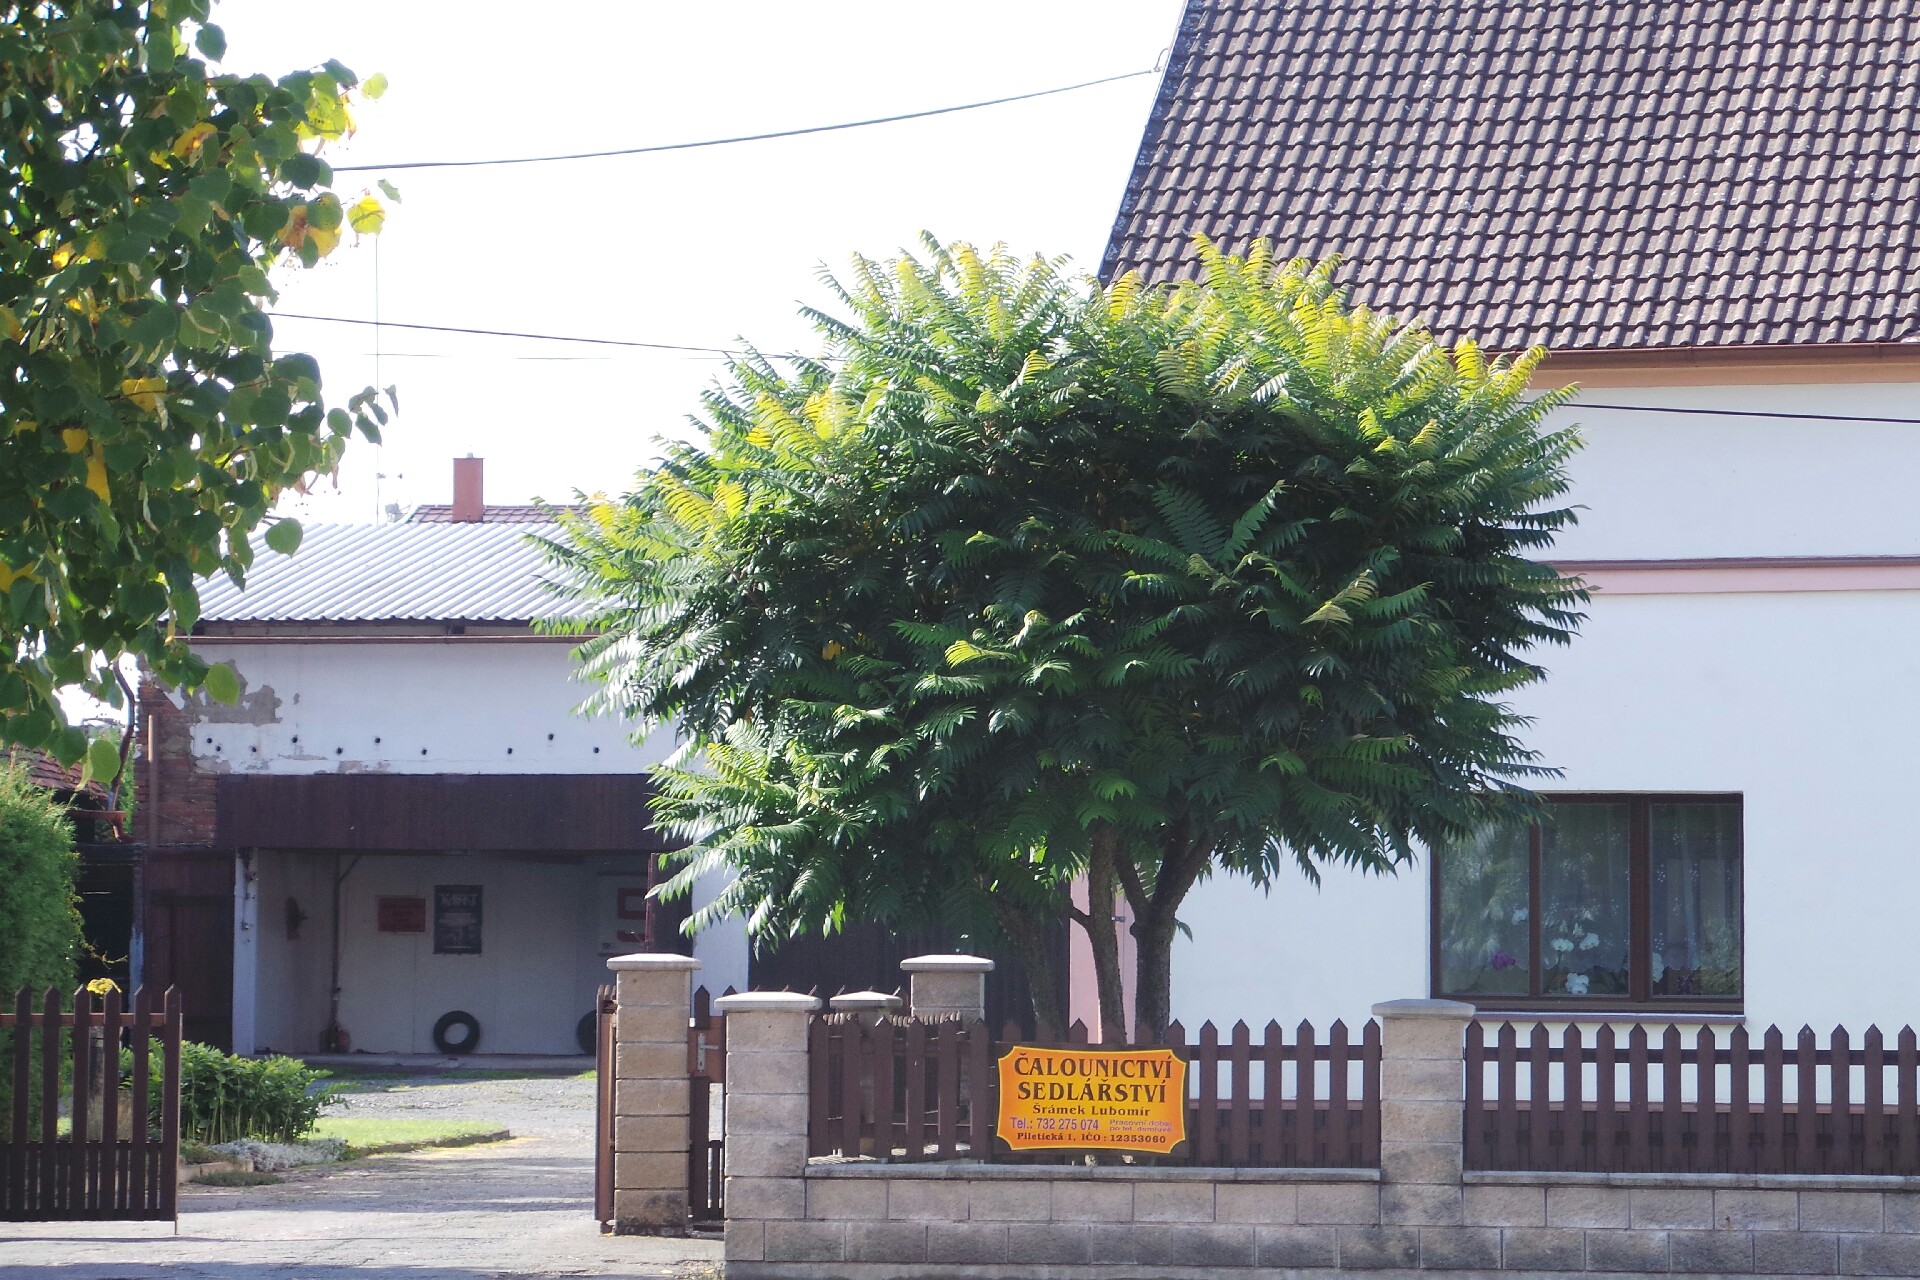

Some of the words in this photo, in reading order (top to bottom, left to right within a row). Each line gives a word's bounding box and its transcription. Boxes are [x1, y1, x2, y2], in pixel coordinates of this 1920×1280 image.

[1014, 1052, 1172, 1079] ČALOUNICTVÍ
[1017, 1078, 1166, 1103] SEDLÁŘSTVÍ
[1033, 1103, 1085, 1115] Šrámek
[1091, 1106, 1151, 1116] Lubomír
[1010, 1115, 1033, 1129] Tel.:
[1036, 1117, 1055, 1130] 732
[1058, 1118, 1078, 1131] 275
[1080, 1119, 1099, 1131] 074
[1017, 1132, 1063, 1141] Piletická
[1081, 1131, 1101, 1141] IČO
